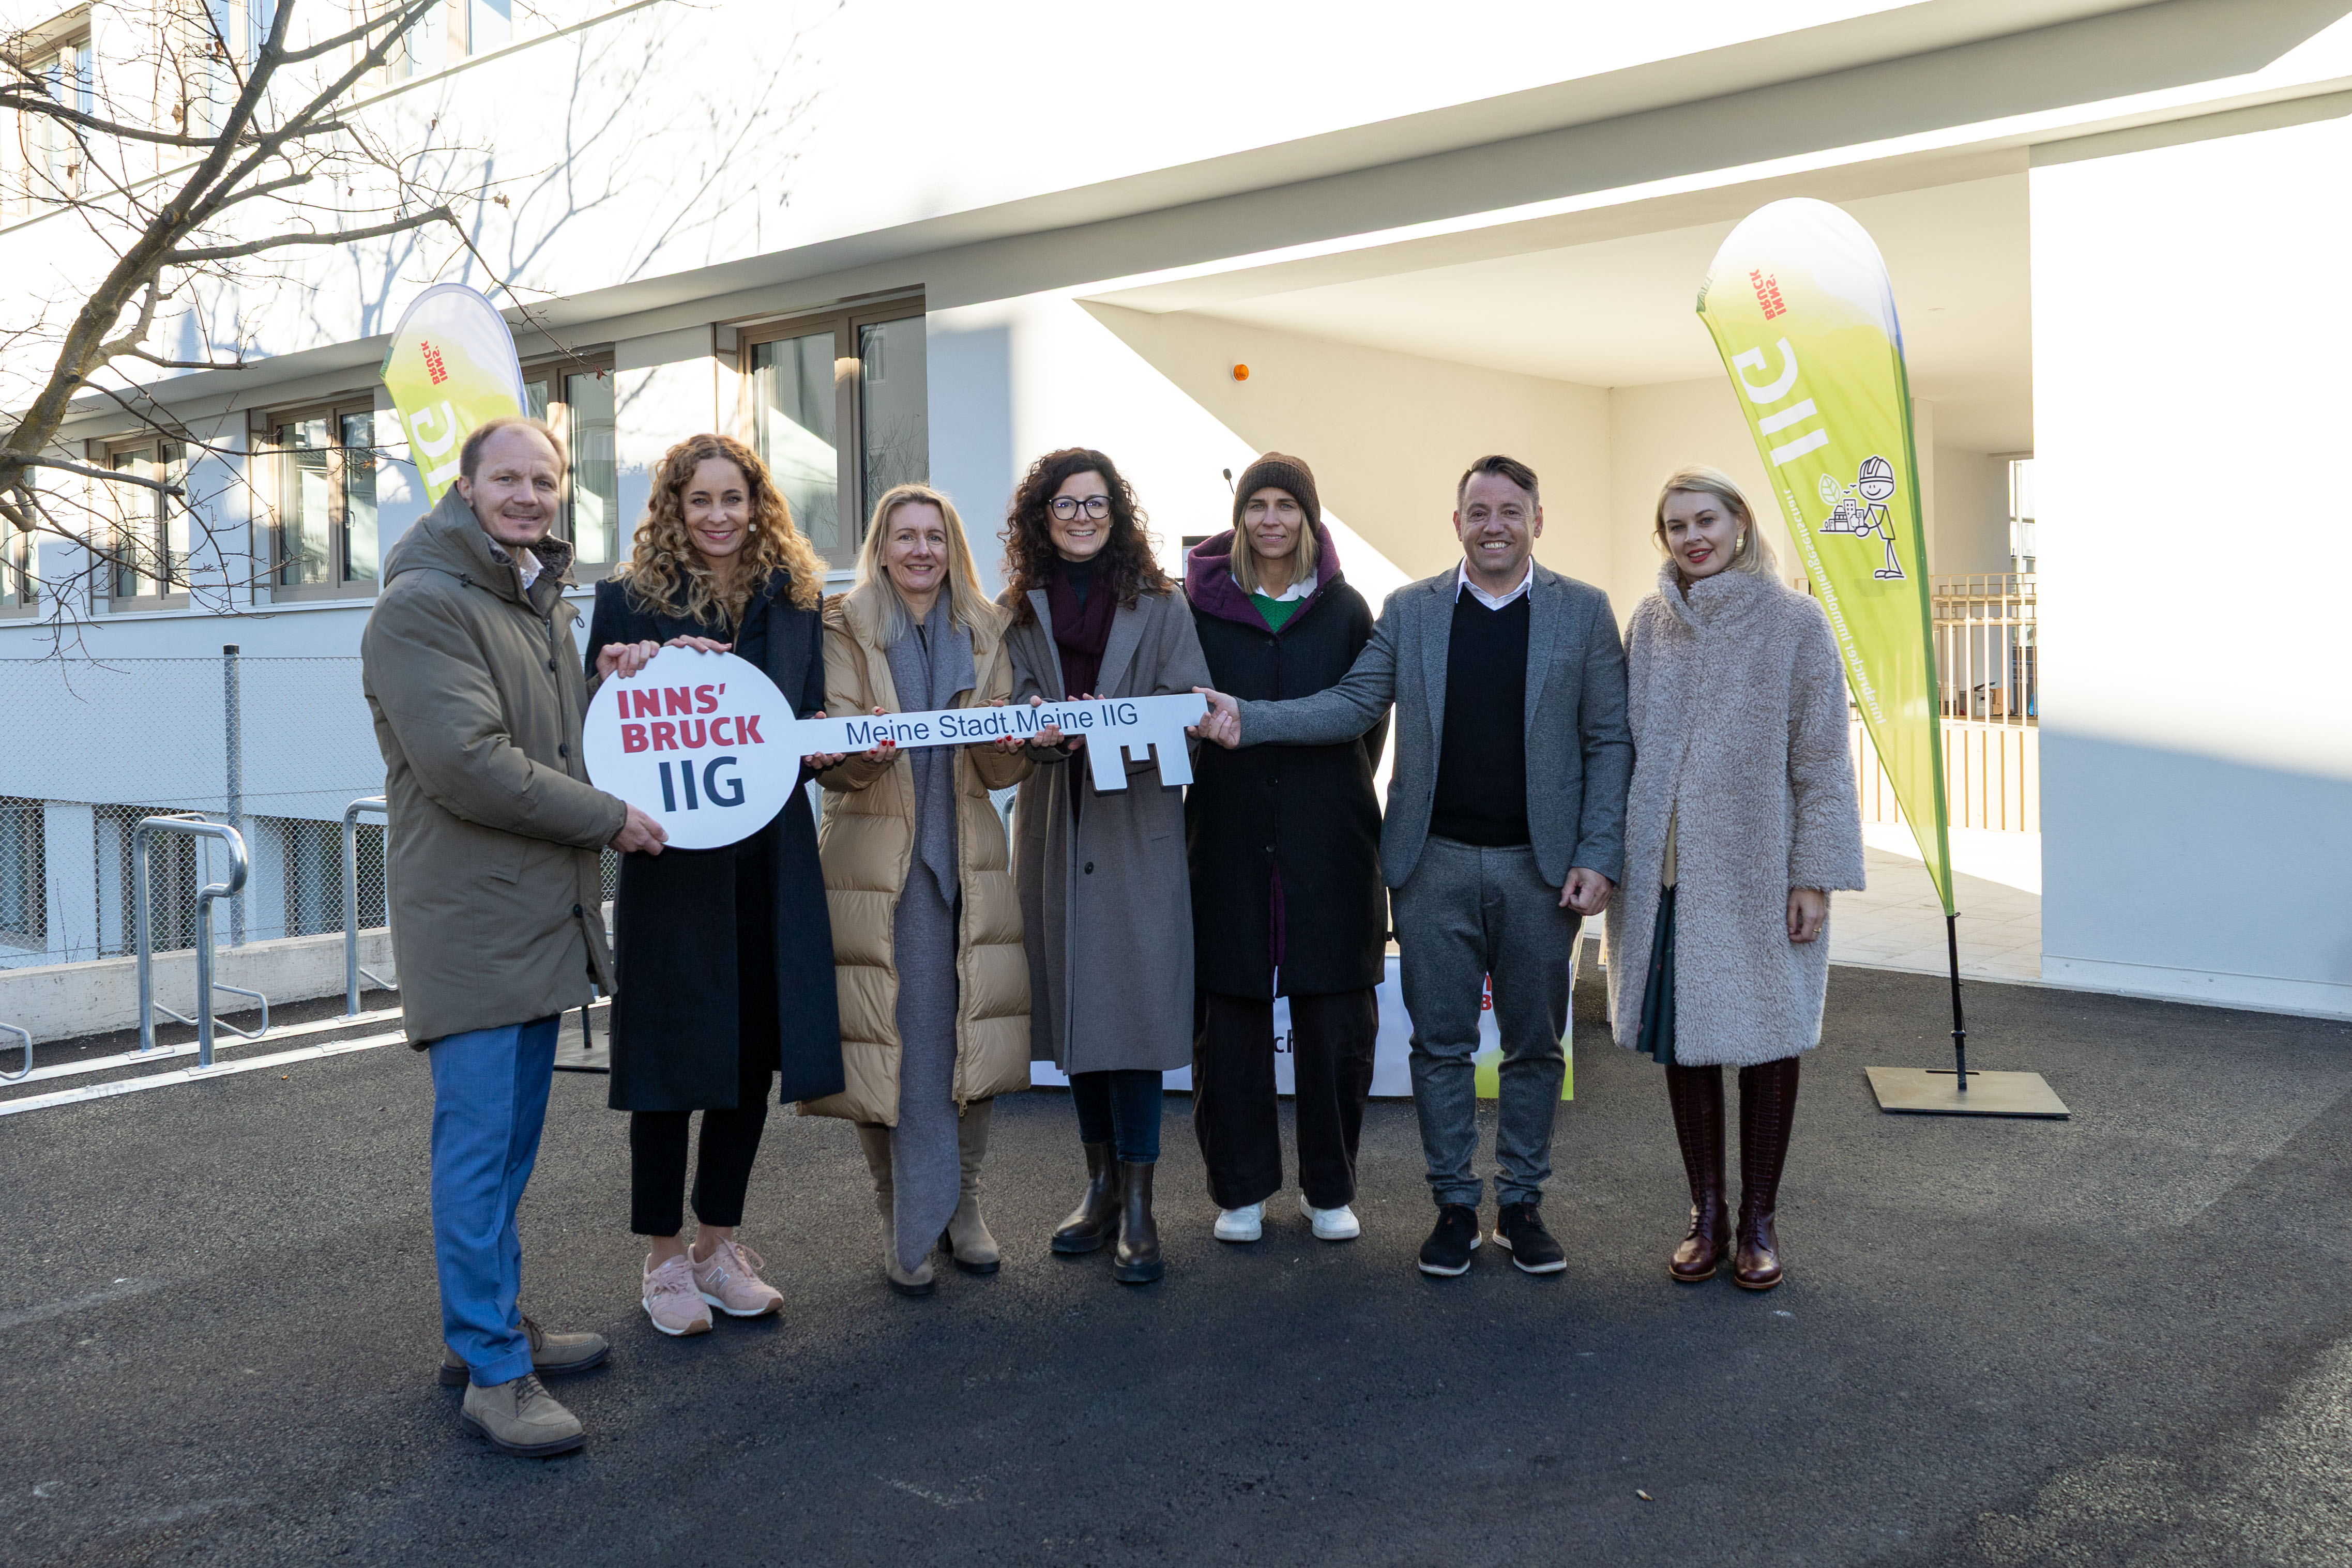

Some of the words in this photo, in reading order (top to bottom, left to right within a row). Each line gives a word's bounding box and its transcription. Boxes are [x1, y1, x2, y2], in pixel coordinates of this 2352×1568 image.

[617, 683, 726, 719] INNS'
[621, 714, 764, 753] BRUCK
[846, 719, 930, 745] Meine
[1102, 703, 1137, 726] IIG
[659, 756, 745, 812] IIG
[706, 1266, 730, 1291] N
